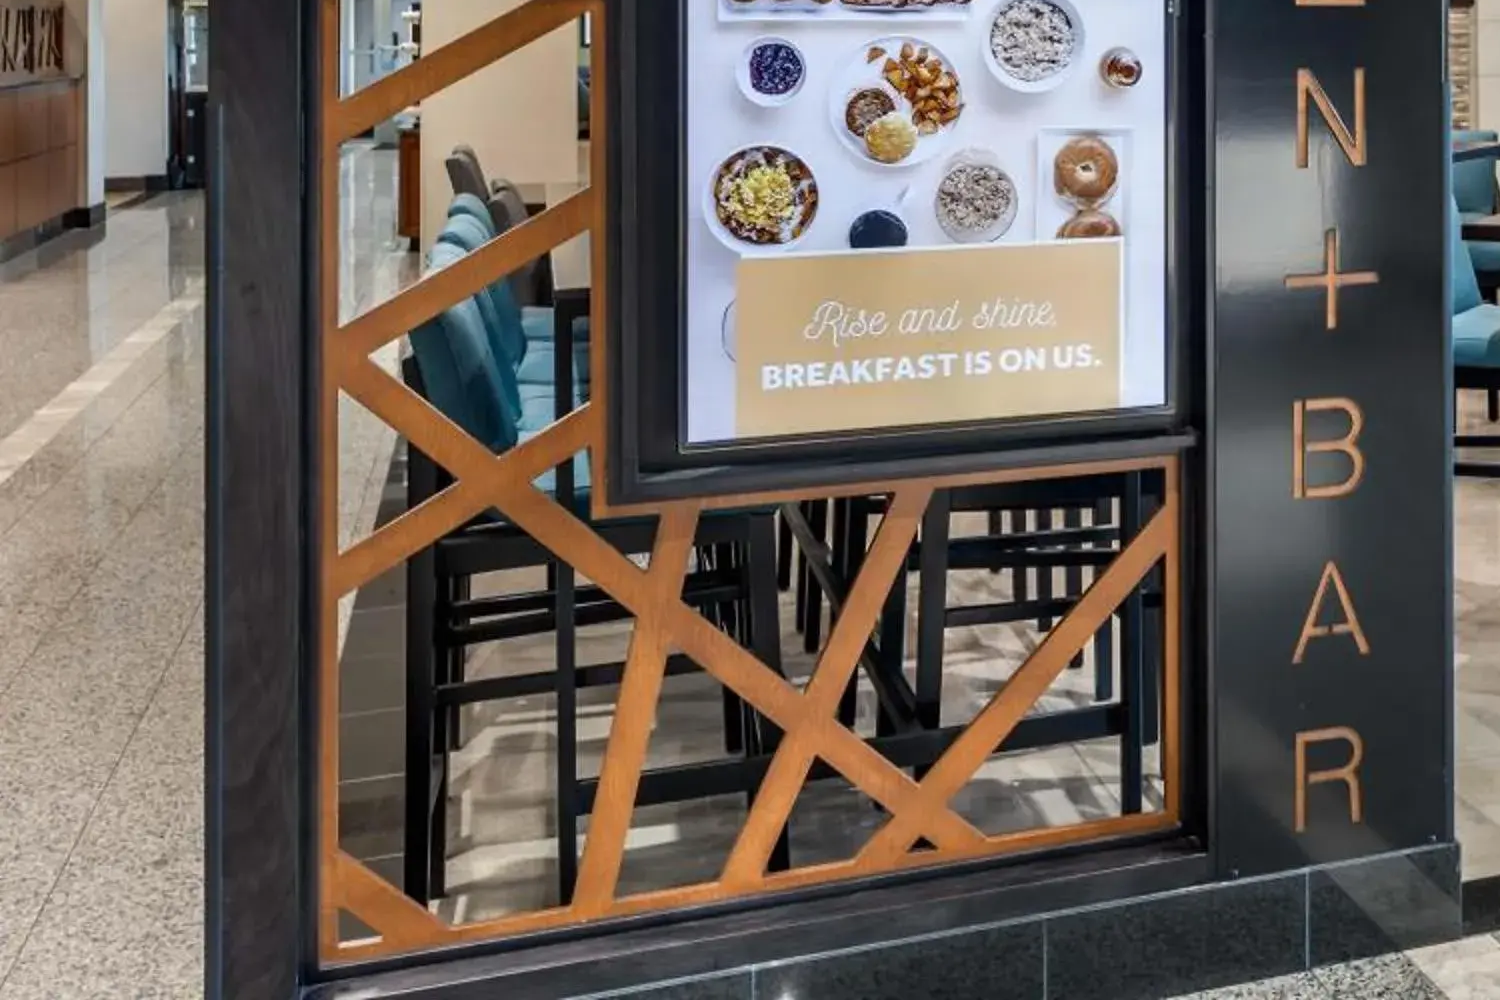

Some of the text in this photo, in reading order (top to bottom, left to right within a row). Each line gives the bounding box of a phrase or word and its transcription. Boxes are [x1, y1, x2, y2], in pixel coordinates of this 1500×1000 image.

[804, 300, 889, 347] Rise
[898, 300, 962, 335] and
[761, 343, 1103, 391] BREAKFAST IS ON US.
[1291, 397, 1371, 833] BAR
